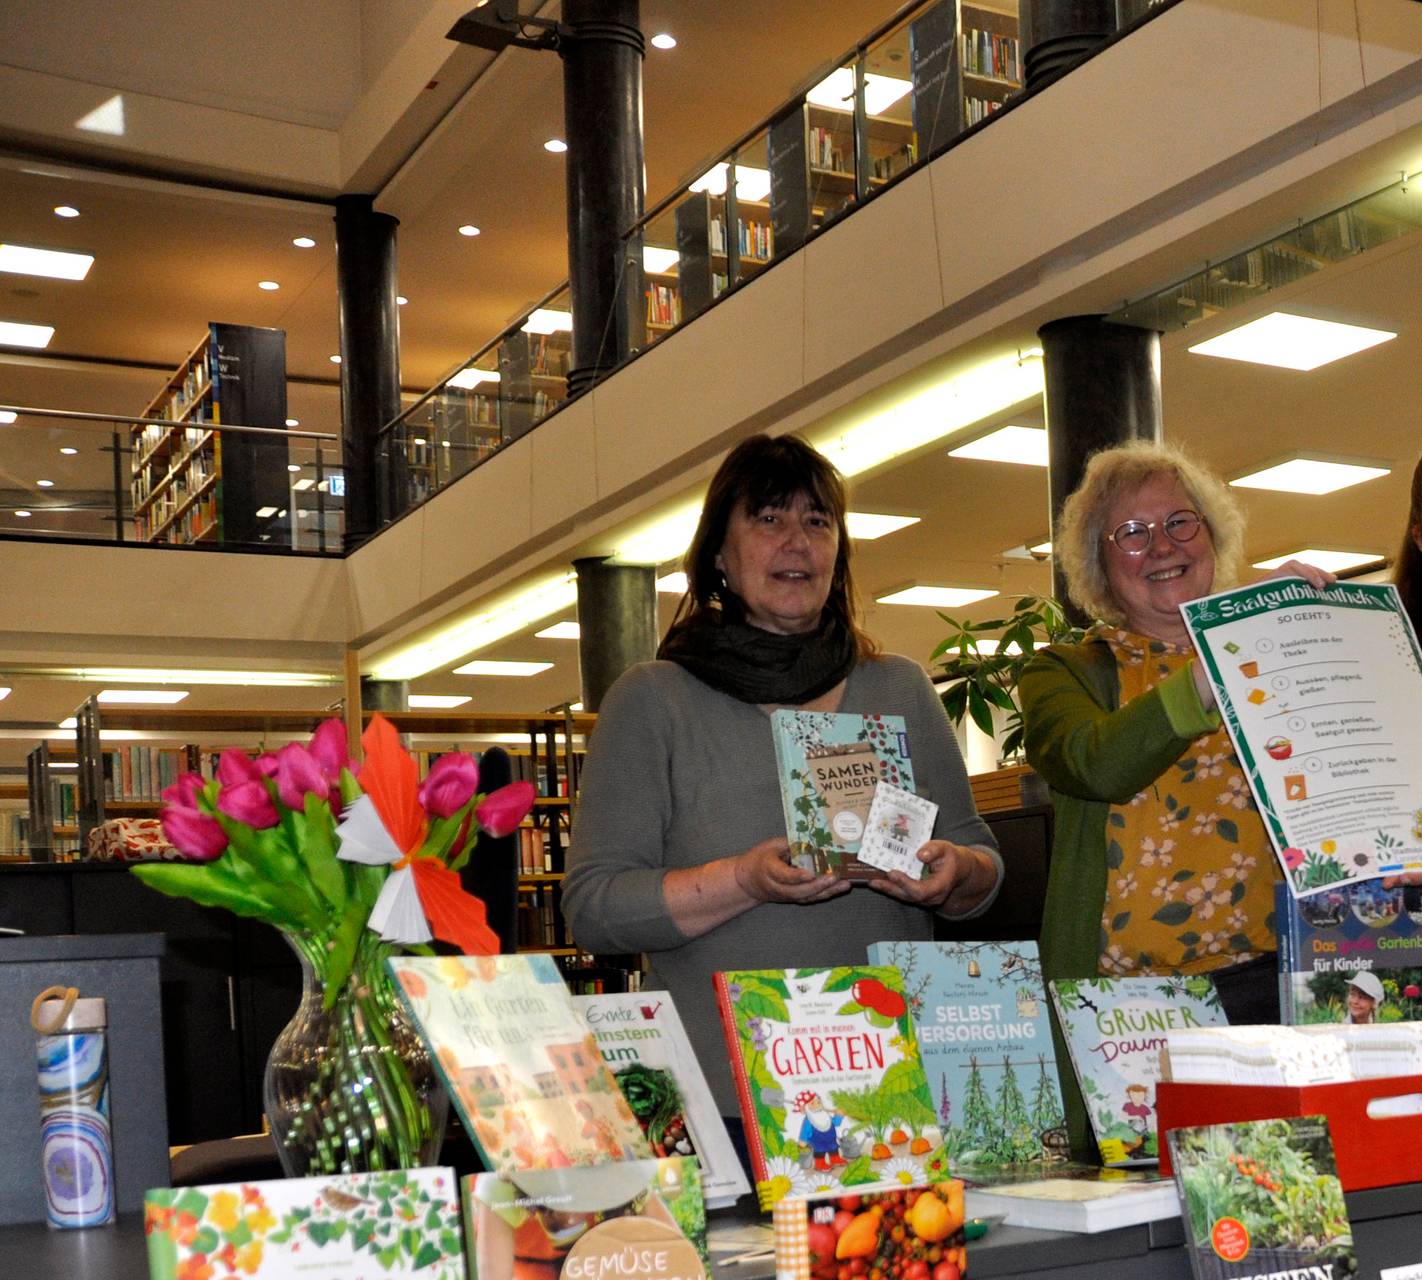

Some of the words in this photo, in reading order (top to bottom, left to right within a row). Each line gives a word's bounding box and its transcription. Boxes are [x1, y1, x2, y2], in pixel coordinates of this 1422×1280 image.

[1219, 583, 1374, 618] Saatgutbibliothek
[1277, 614, 1292, 624] SO
[1294, 611, 1332, 622] GEHT'S
[816, 761, 876, 782] SAMEN
[820, 775, 878, 792] WUNDER
[1312, 939, 1337, 953] Das
[1313, 958, 1332, 972] für
[1333, 955, 1374, 972] Kinder
[585, 1004, 637, 1024] Ernte
[935, 1004, 1002, 1023] SELBST
[1096, 1005, 1202, 1037] GRÜNER
[593, 1027, 662, 1043] instem
[772, 1033, 885, 1077] GARTEN
[1088, 1037, 1168, 1064] Daum
[566, 1246, 669, 1278] GEMÜSE
